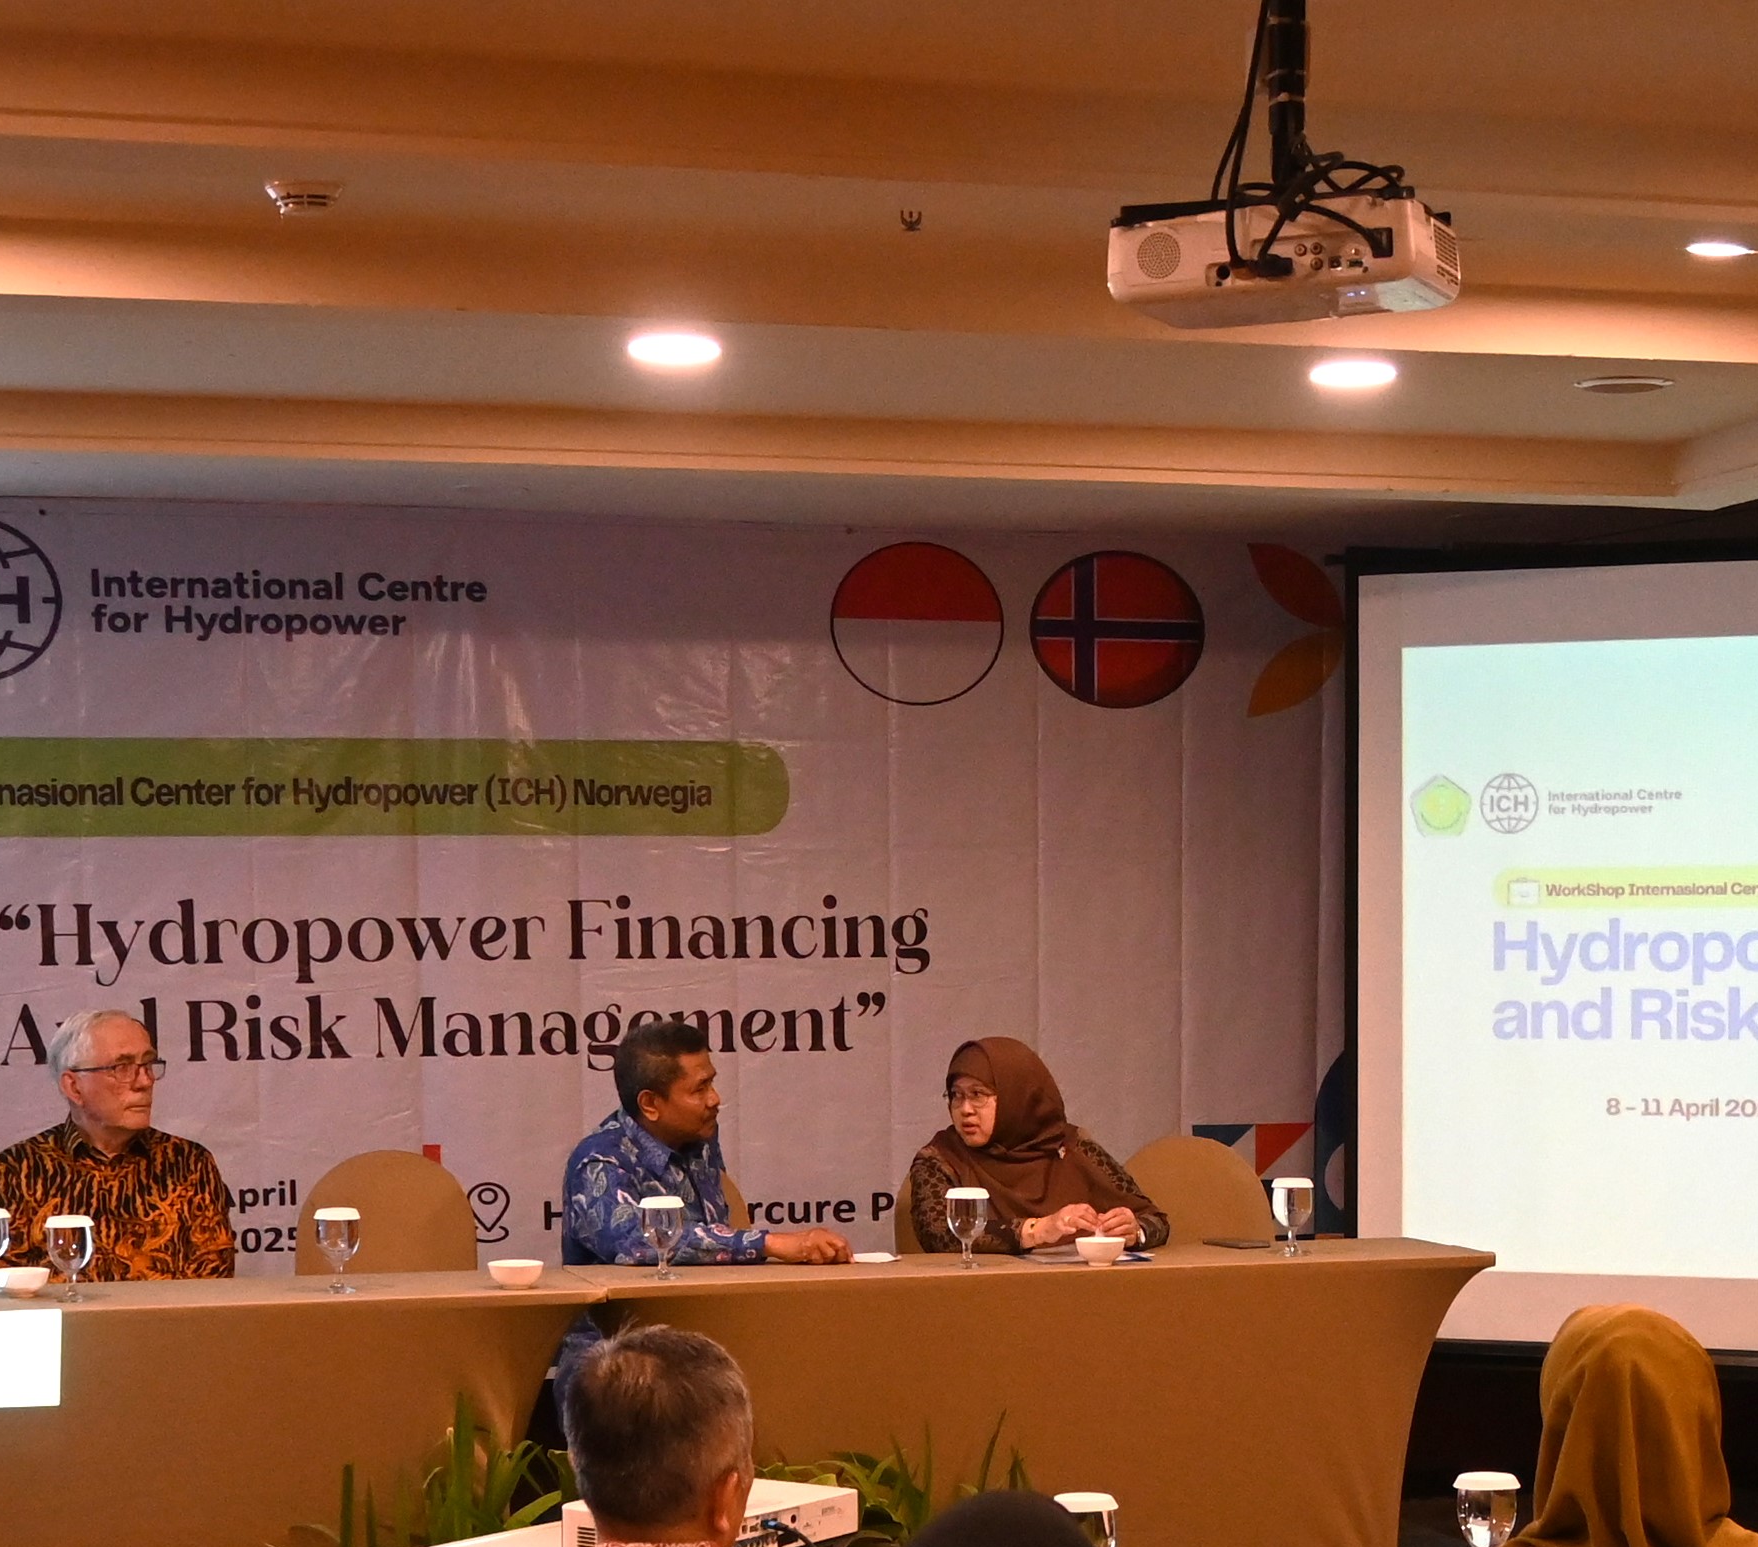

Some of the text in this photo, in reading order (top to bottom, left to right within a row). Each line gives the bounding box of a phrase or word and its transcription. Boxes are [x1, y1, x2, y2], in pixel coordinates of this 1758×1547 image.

[91, 568, 488, 603] International Centre
[92, 604, 407, 642] for Hydropower
[130, 776, 235, 807] Center
[242, 776, 286, 806] for
[292, 776, 478, 813] Hydropower
[485, 773, 568, 813] (ICH)
[573, 778, 713, 815] Norwegia
[1489, 795, 1530, 814] ICH
[1548, 788, 1683, 803] International Centre
[1548, 803, 1654, 817] for Hydropower
[1545, 882, 1625, 899] WorkShop
[1628, 882, 1728, 897] Internasional
[567, 894, 932, 975] Financing
[186, 994, 353, 1062] Risk
[1491, 986, 1613, 1041] and
[1606, 1097, 1622, 1117] 8
[1642, 1097, 1665, 1118] 11
[1668, 1097, 1720, 1122] April
